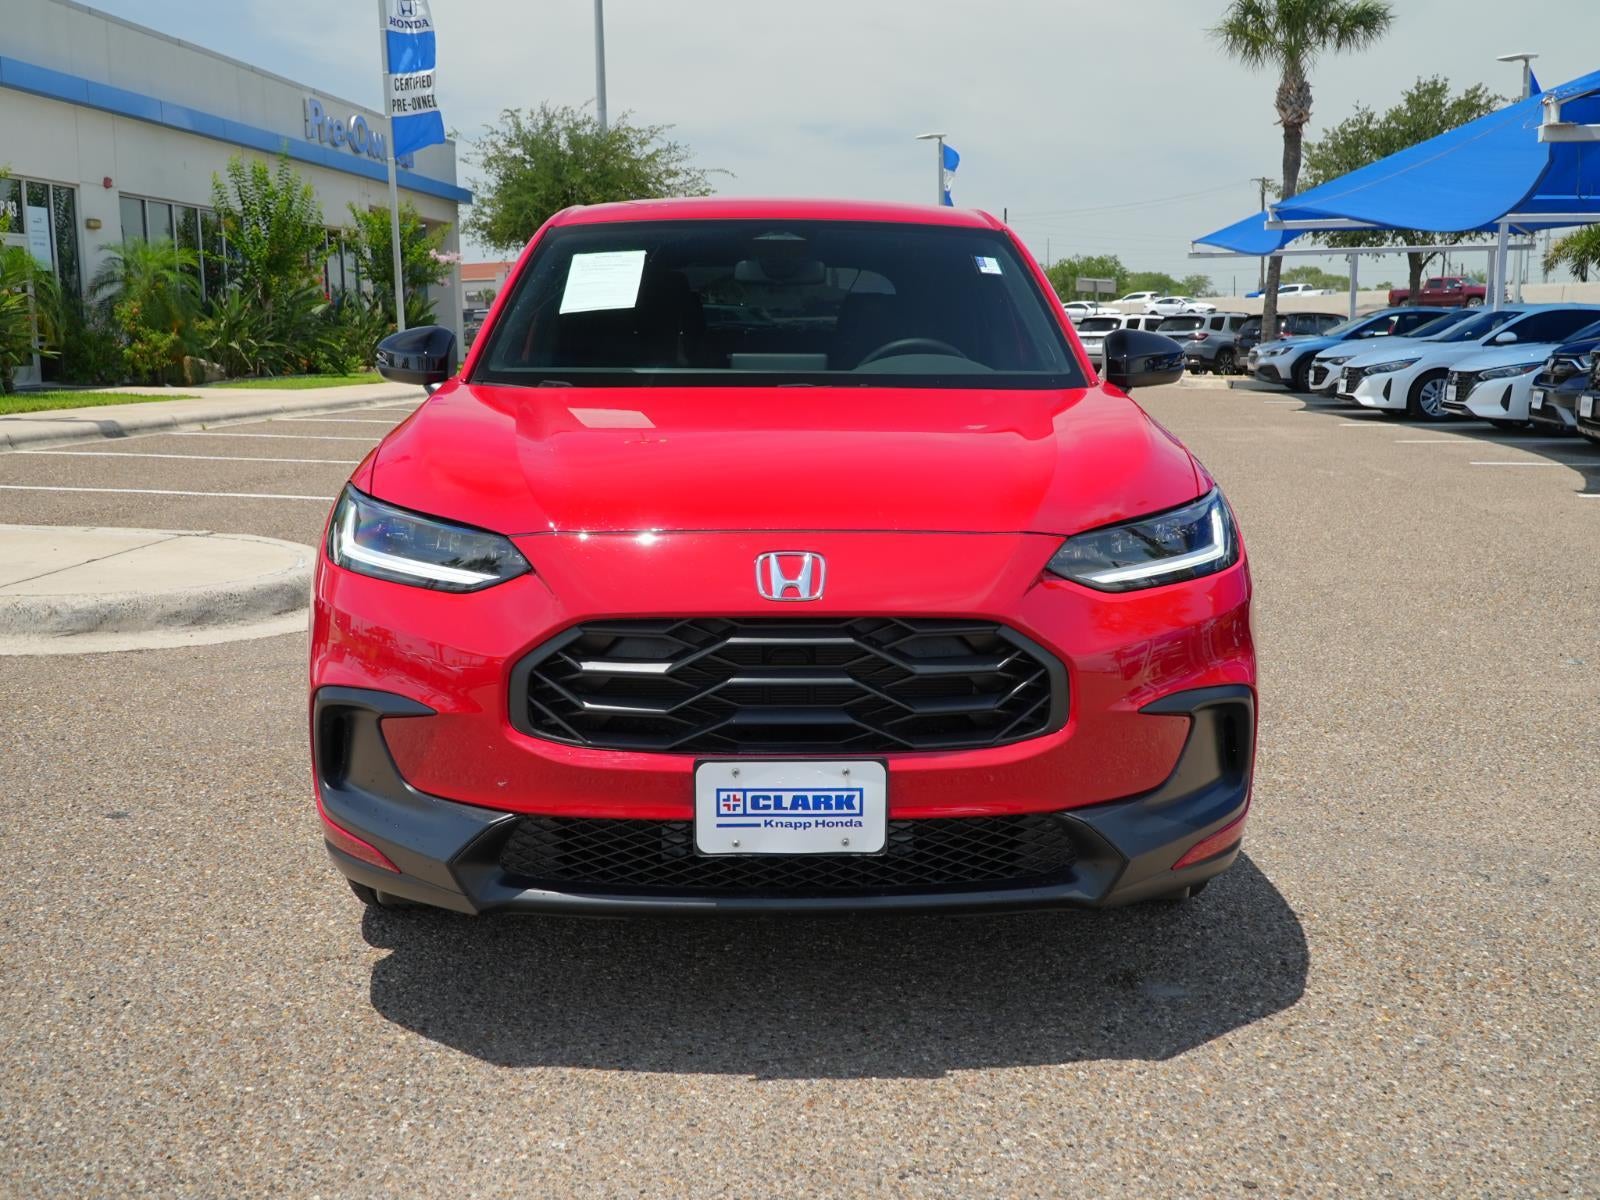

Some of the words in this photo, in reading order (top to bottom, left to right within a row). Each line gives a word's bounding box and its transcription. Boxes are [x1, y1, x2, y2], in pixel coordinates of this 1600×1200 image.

[389, 16, 429, 29] HONDA
[394, 74, 432, 91] CERTIFIED
[304, 97, 414, 169] Pre-Ow
[750, 794, 856, 811] CLARK
[763, 819, 812, 830] Knapp
[814, 819, 863, 828] Honda
